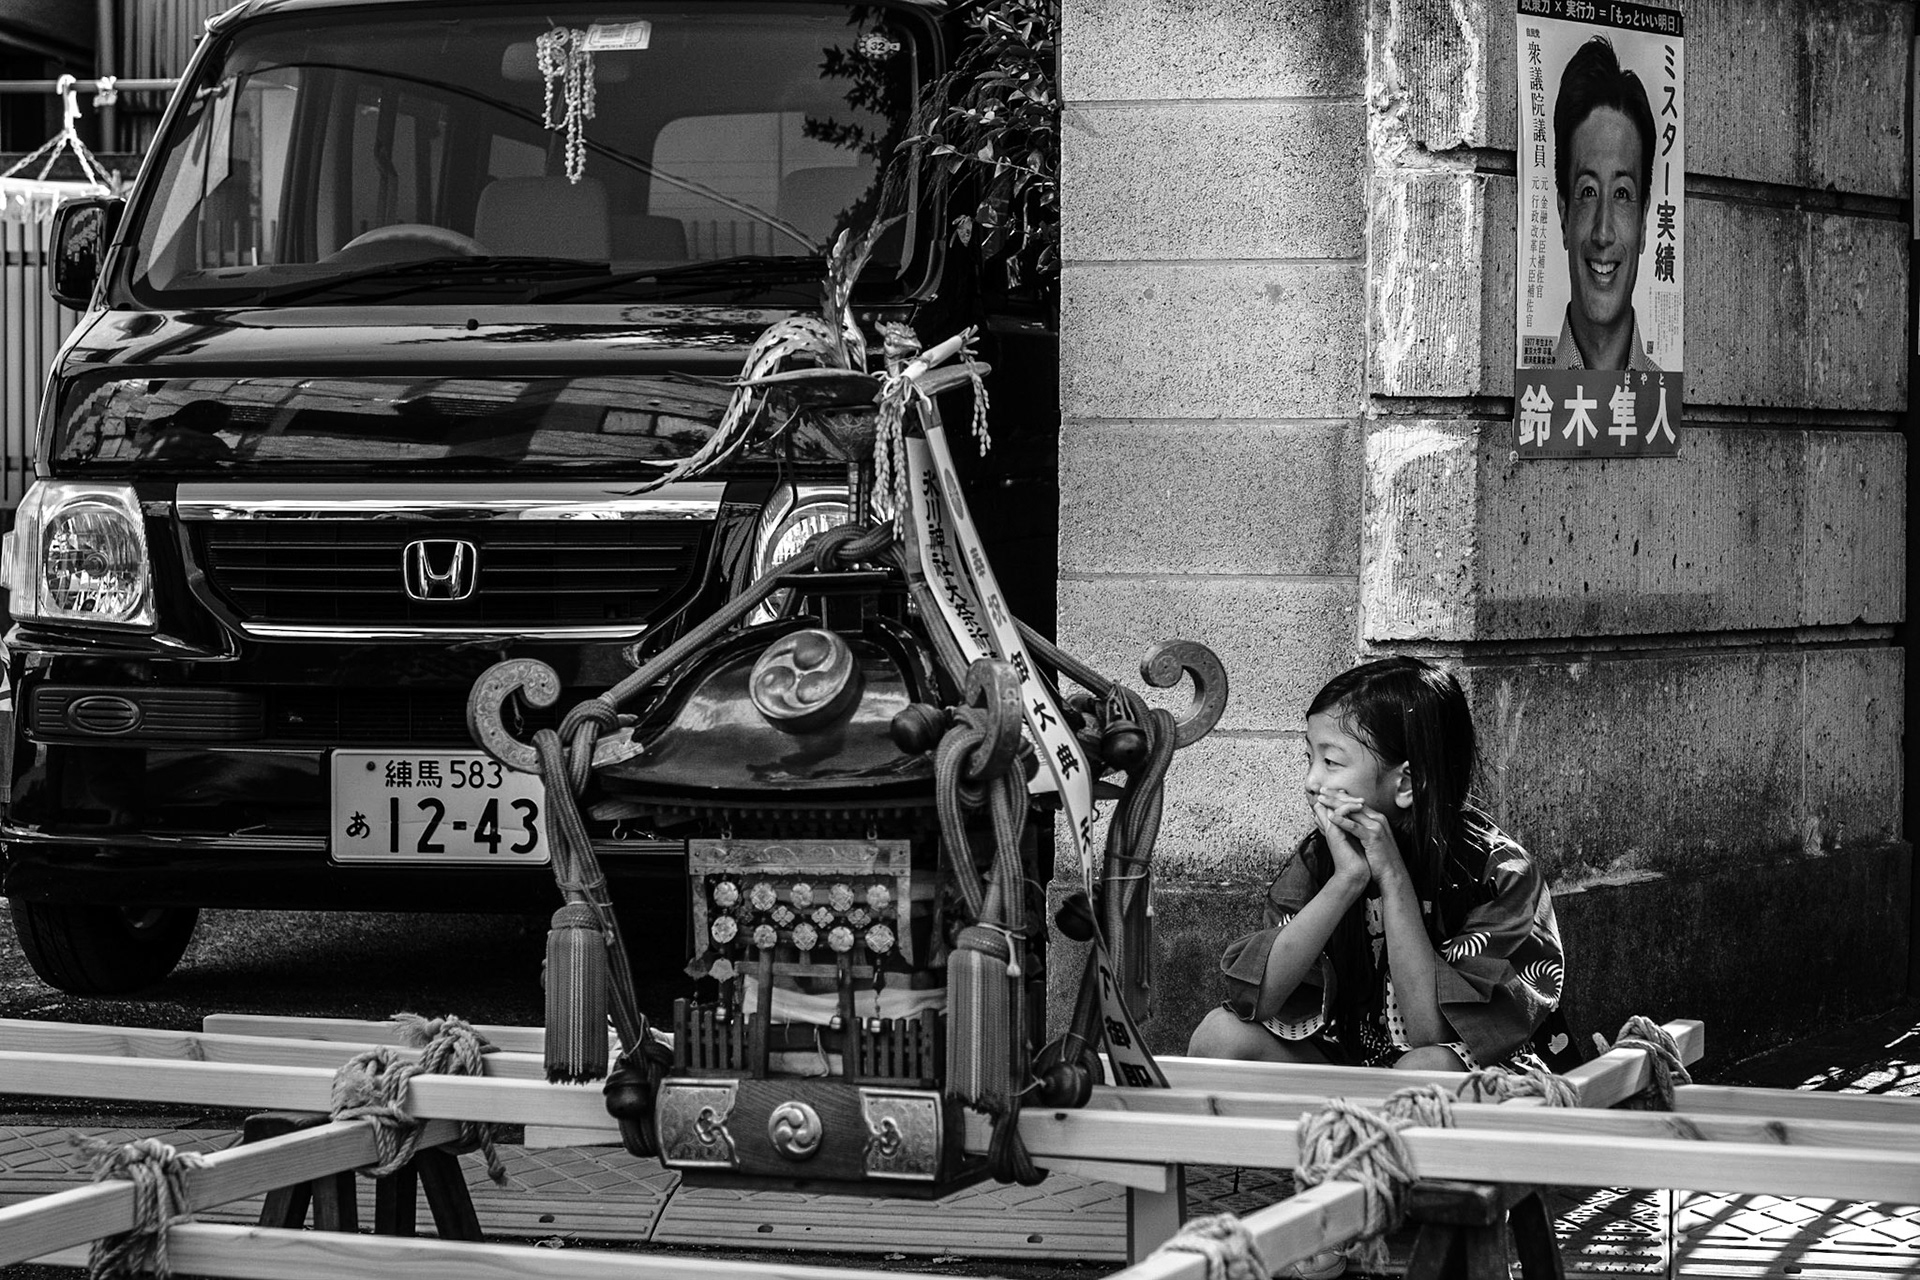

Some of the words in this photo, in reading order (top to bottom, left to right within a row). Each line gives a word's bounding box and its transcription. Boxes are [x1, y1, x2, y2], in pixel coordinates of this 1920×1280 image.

[1528, 41, 1547, 168] 衆議院議員
[1654, 44, 1678, 284] ミスター実績
[1624, 372, 1665, 386] はやと
[1518, 384, 1676, 447] 鈴木隼人
[385, 760, 442, 788] 練馬
[450, 760, 503, 789] 583
[346, 811, 370, 839] あ
[390, 797, 538, 854] 12-43
